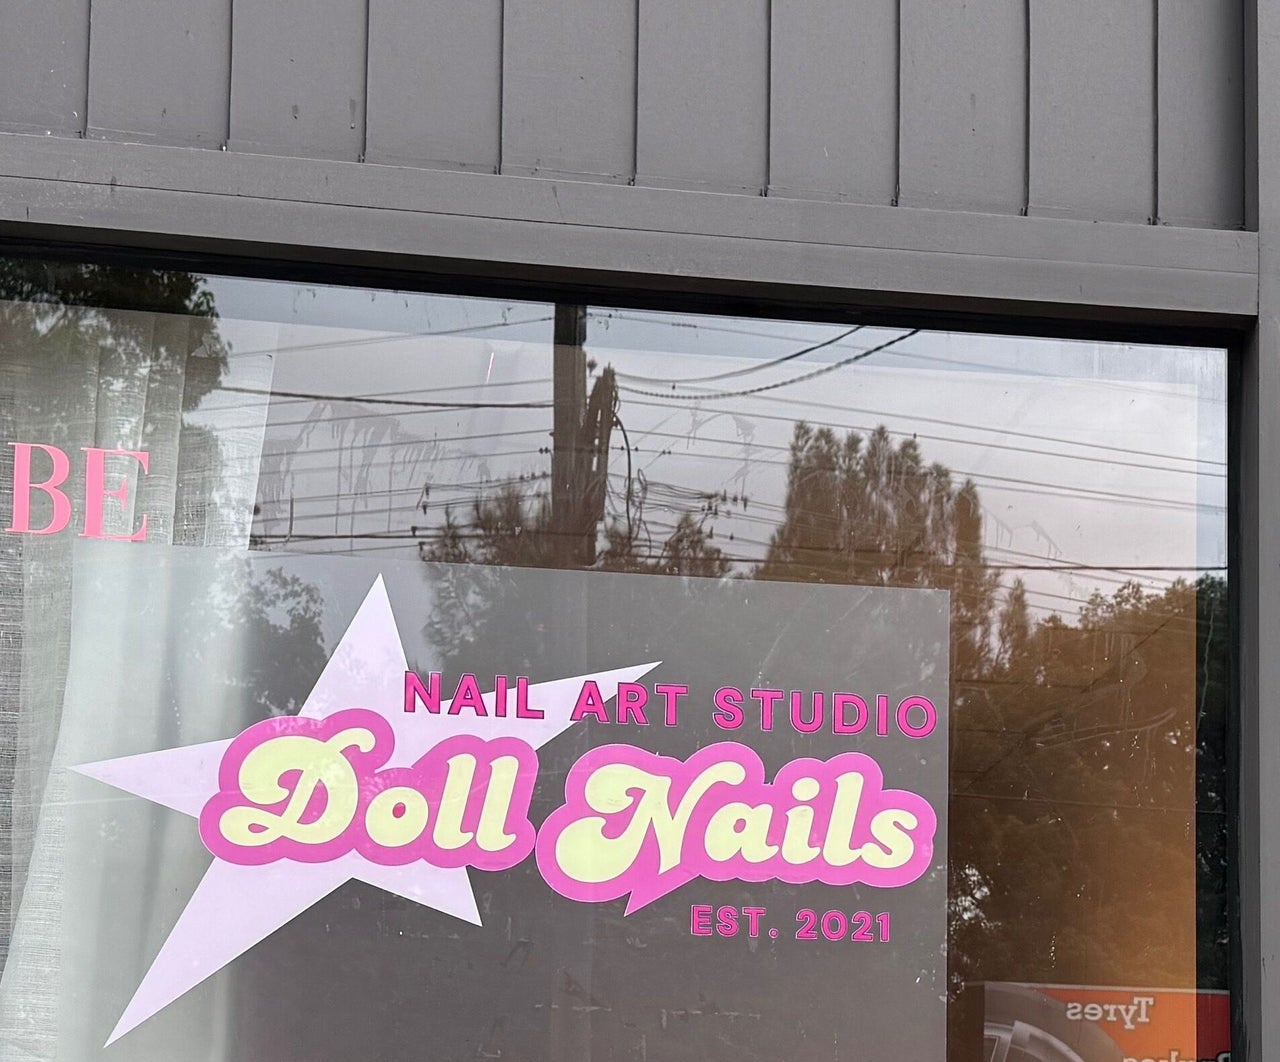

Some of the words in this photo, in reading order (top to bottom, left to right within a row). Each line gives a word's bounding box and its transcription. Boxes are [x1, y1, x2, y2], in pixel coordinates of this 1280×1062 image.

[5, 441, 150, 541] BE
[403, 670, 545, 720] NAIL
[570, 679, 689, 727] ART
[713, 686, 938, 738] STUDIO
[217, 727, 521, 853] Doll
[554, 760, 920, 885] Nails
[690, 904, 778, 940] EST.
[796, 909, 891, 943] 2021
